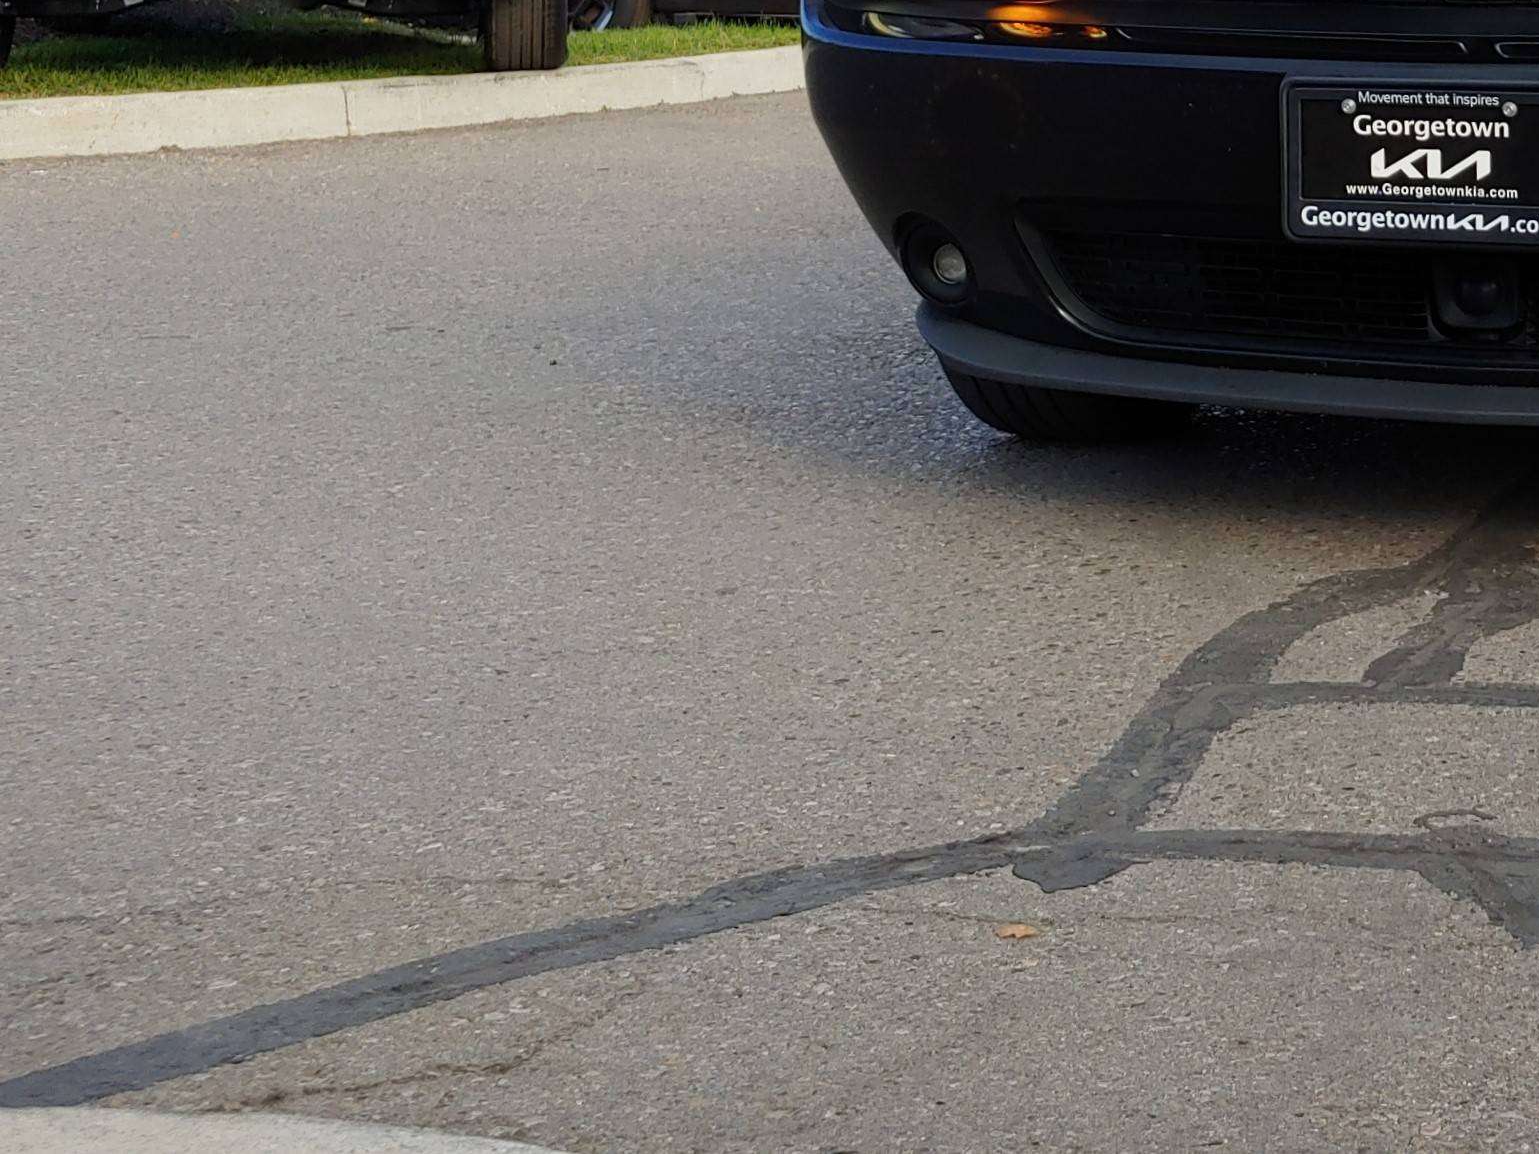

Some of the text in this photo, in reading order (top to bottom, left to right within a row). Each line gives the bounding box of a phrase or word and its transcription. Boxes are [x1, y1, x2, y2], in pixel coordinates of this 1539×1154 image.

[1357, 91, 1500, 108] Movement that inspires
[1353, 114, 1510, 141] Georgetown
[1371, 147, 1491, 180] KIA
[1346, 183, 1518, 199] www.Georgetownkia.com
